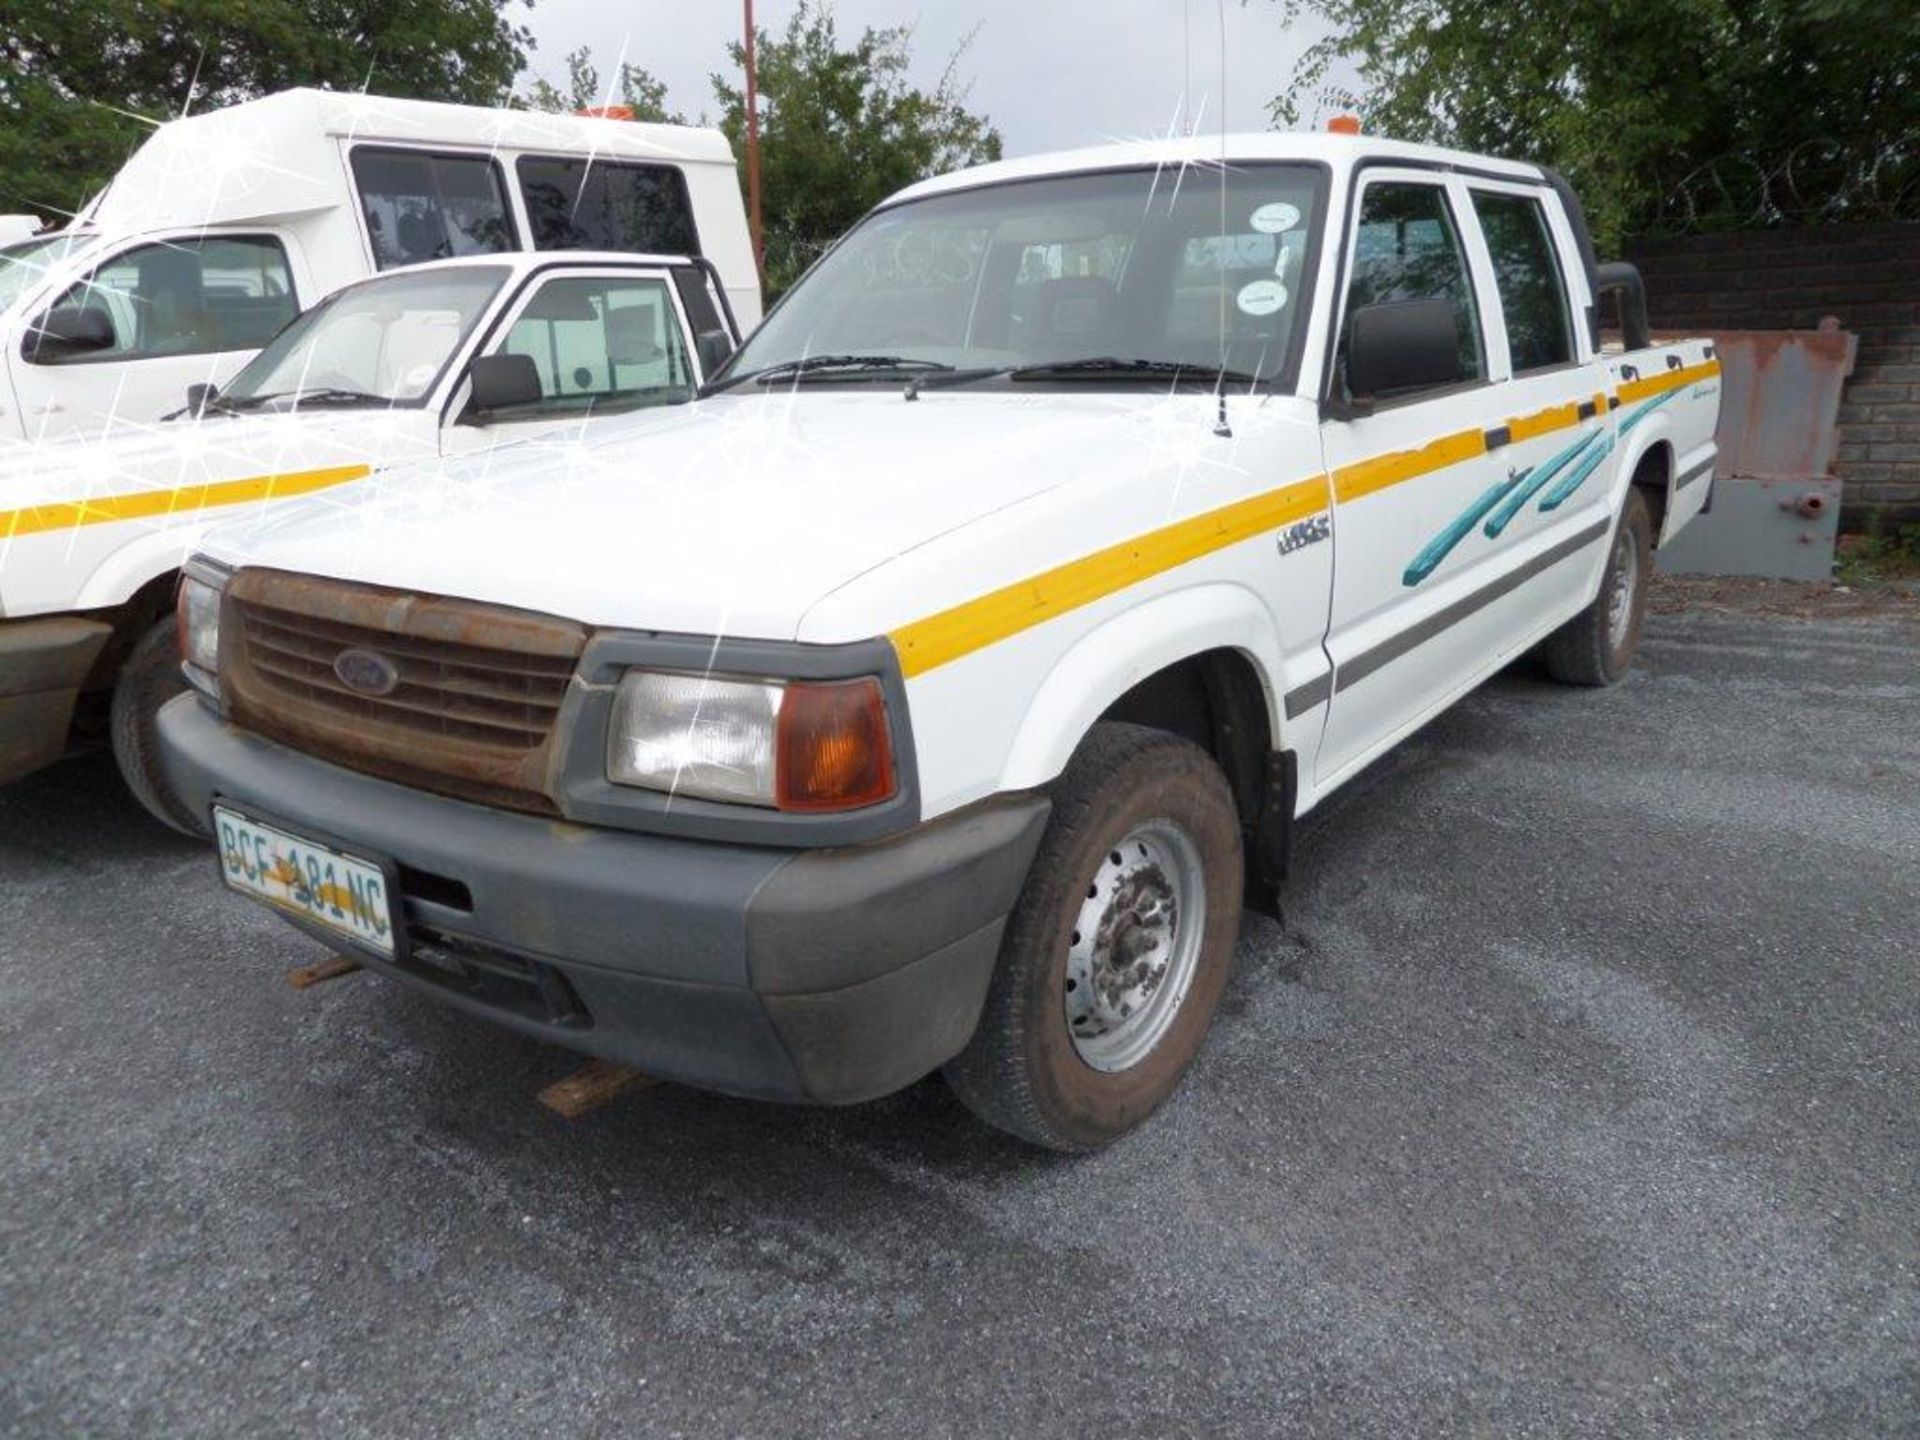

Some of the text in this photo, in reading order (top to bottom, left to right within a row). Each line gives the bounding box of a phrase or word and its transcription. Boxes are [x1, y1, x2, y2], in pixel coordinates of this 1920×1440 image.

[222, 822, 389, 937] BCF 181 NC
